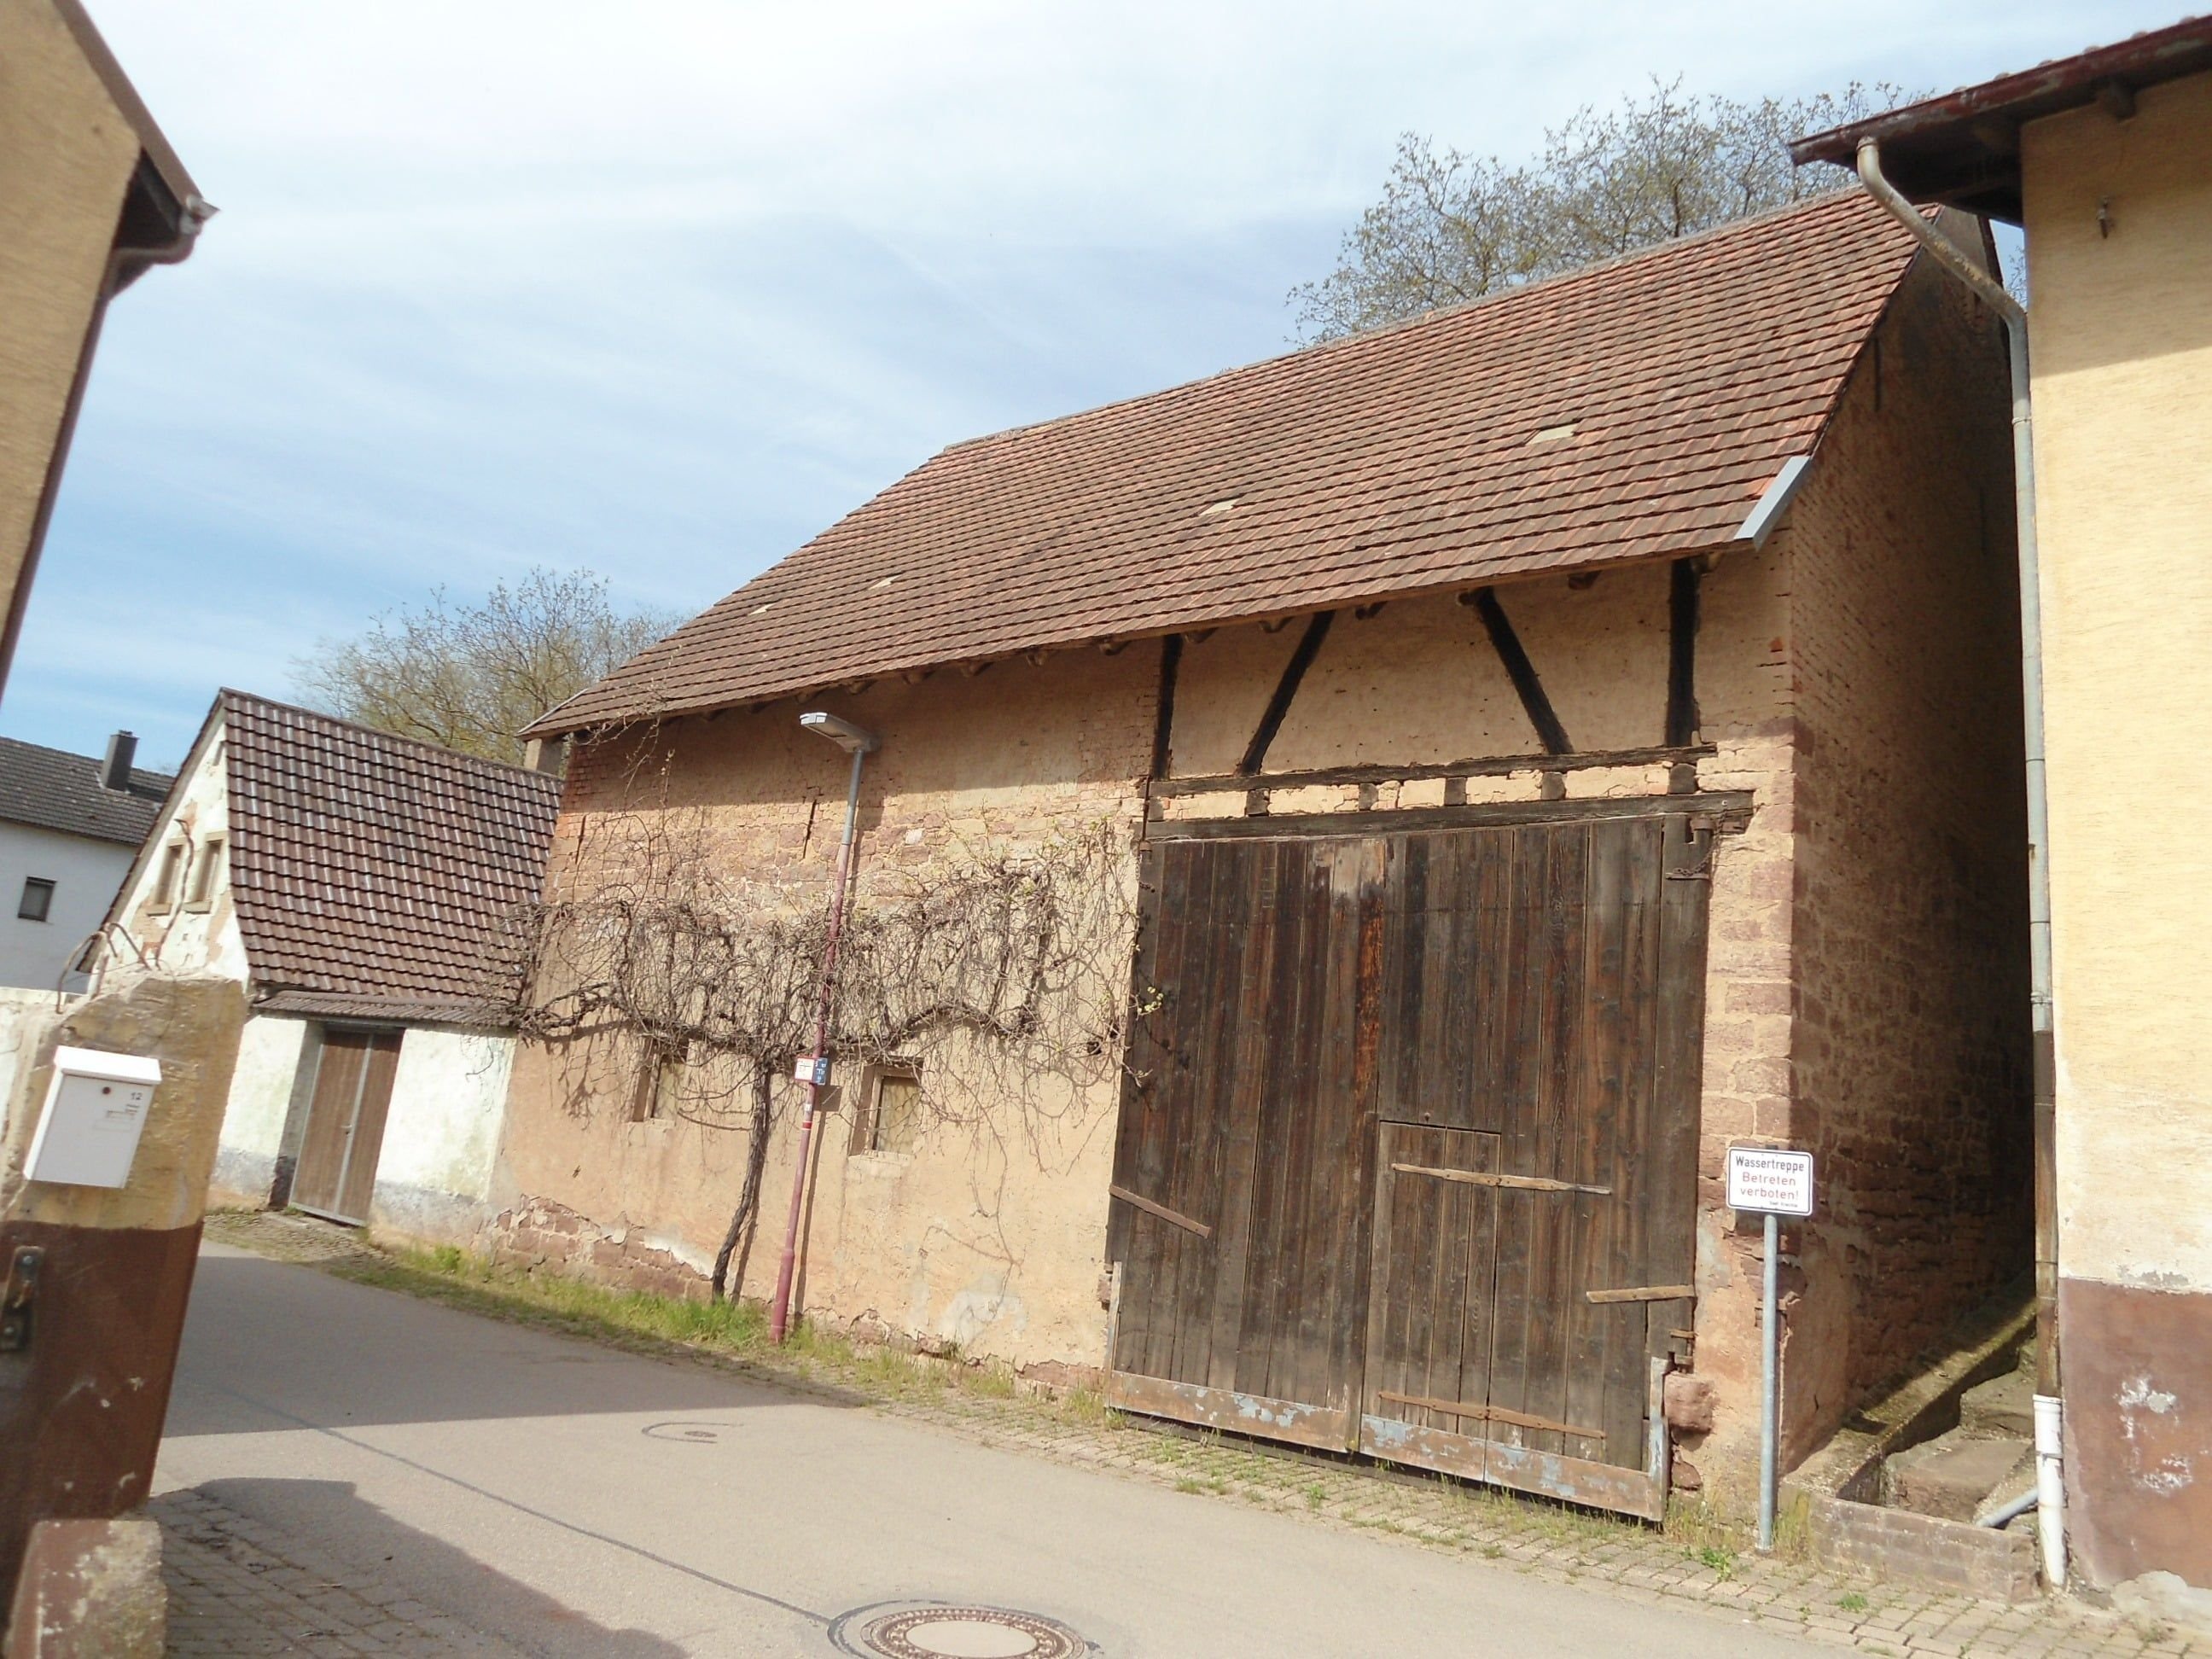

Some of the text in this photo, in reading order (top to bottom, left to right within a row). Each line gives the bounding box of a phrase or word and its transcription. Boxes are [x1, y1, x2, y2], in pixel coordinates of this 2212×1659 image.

[1736, 1155, 1804, 1173] Wassertreppe
[1743, 1172, 1796, 1185] Betreten
[1740, 1188, 1798, 1200] verboten!
